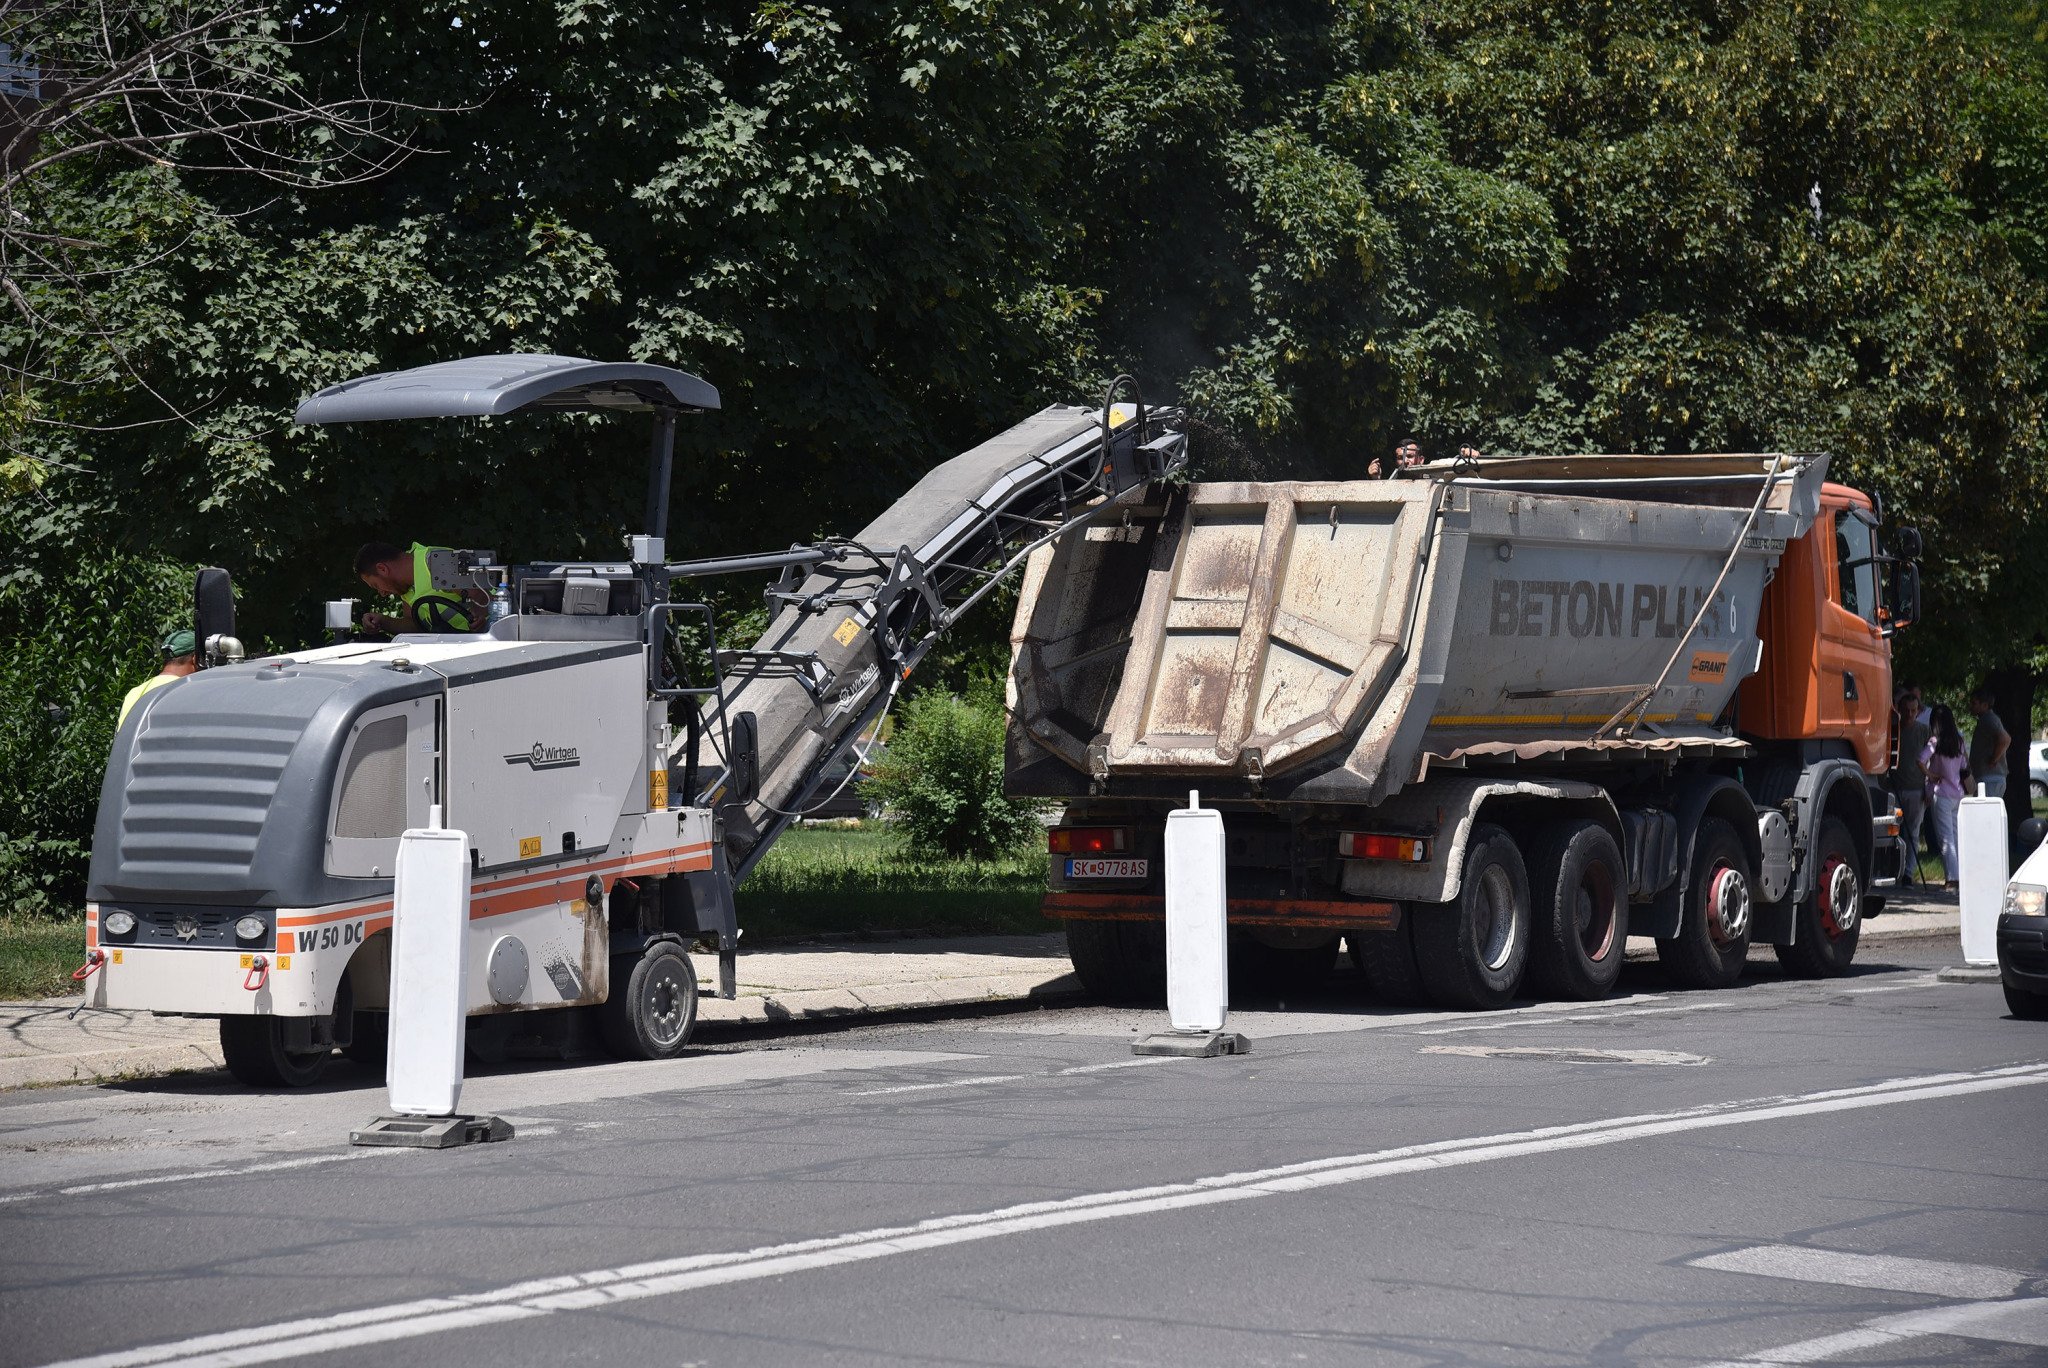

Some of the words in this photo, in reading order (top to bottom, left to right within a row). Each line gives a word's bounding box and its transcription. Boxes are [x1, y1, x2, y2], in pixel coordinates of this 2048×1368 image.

[1489, 580, 1624, 638] BETON
[1730, 595, 1737, 634] 6
[1699, 660, 1727, 673] GRANIT
[545, 747, 577, 761] Wirtgen
[1074, 861, 1088, 875] SK
[1097, 861, 1128, 875] 9778
[1130, 861, 1146, 875] AS
[299, 929, 318, 952] W
[321, 926, 339, 949] 50
[344, 921, 362, 945] DC
